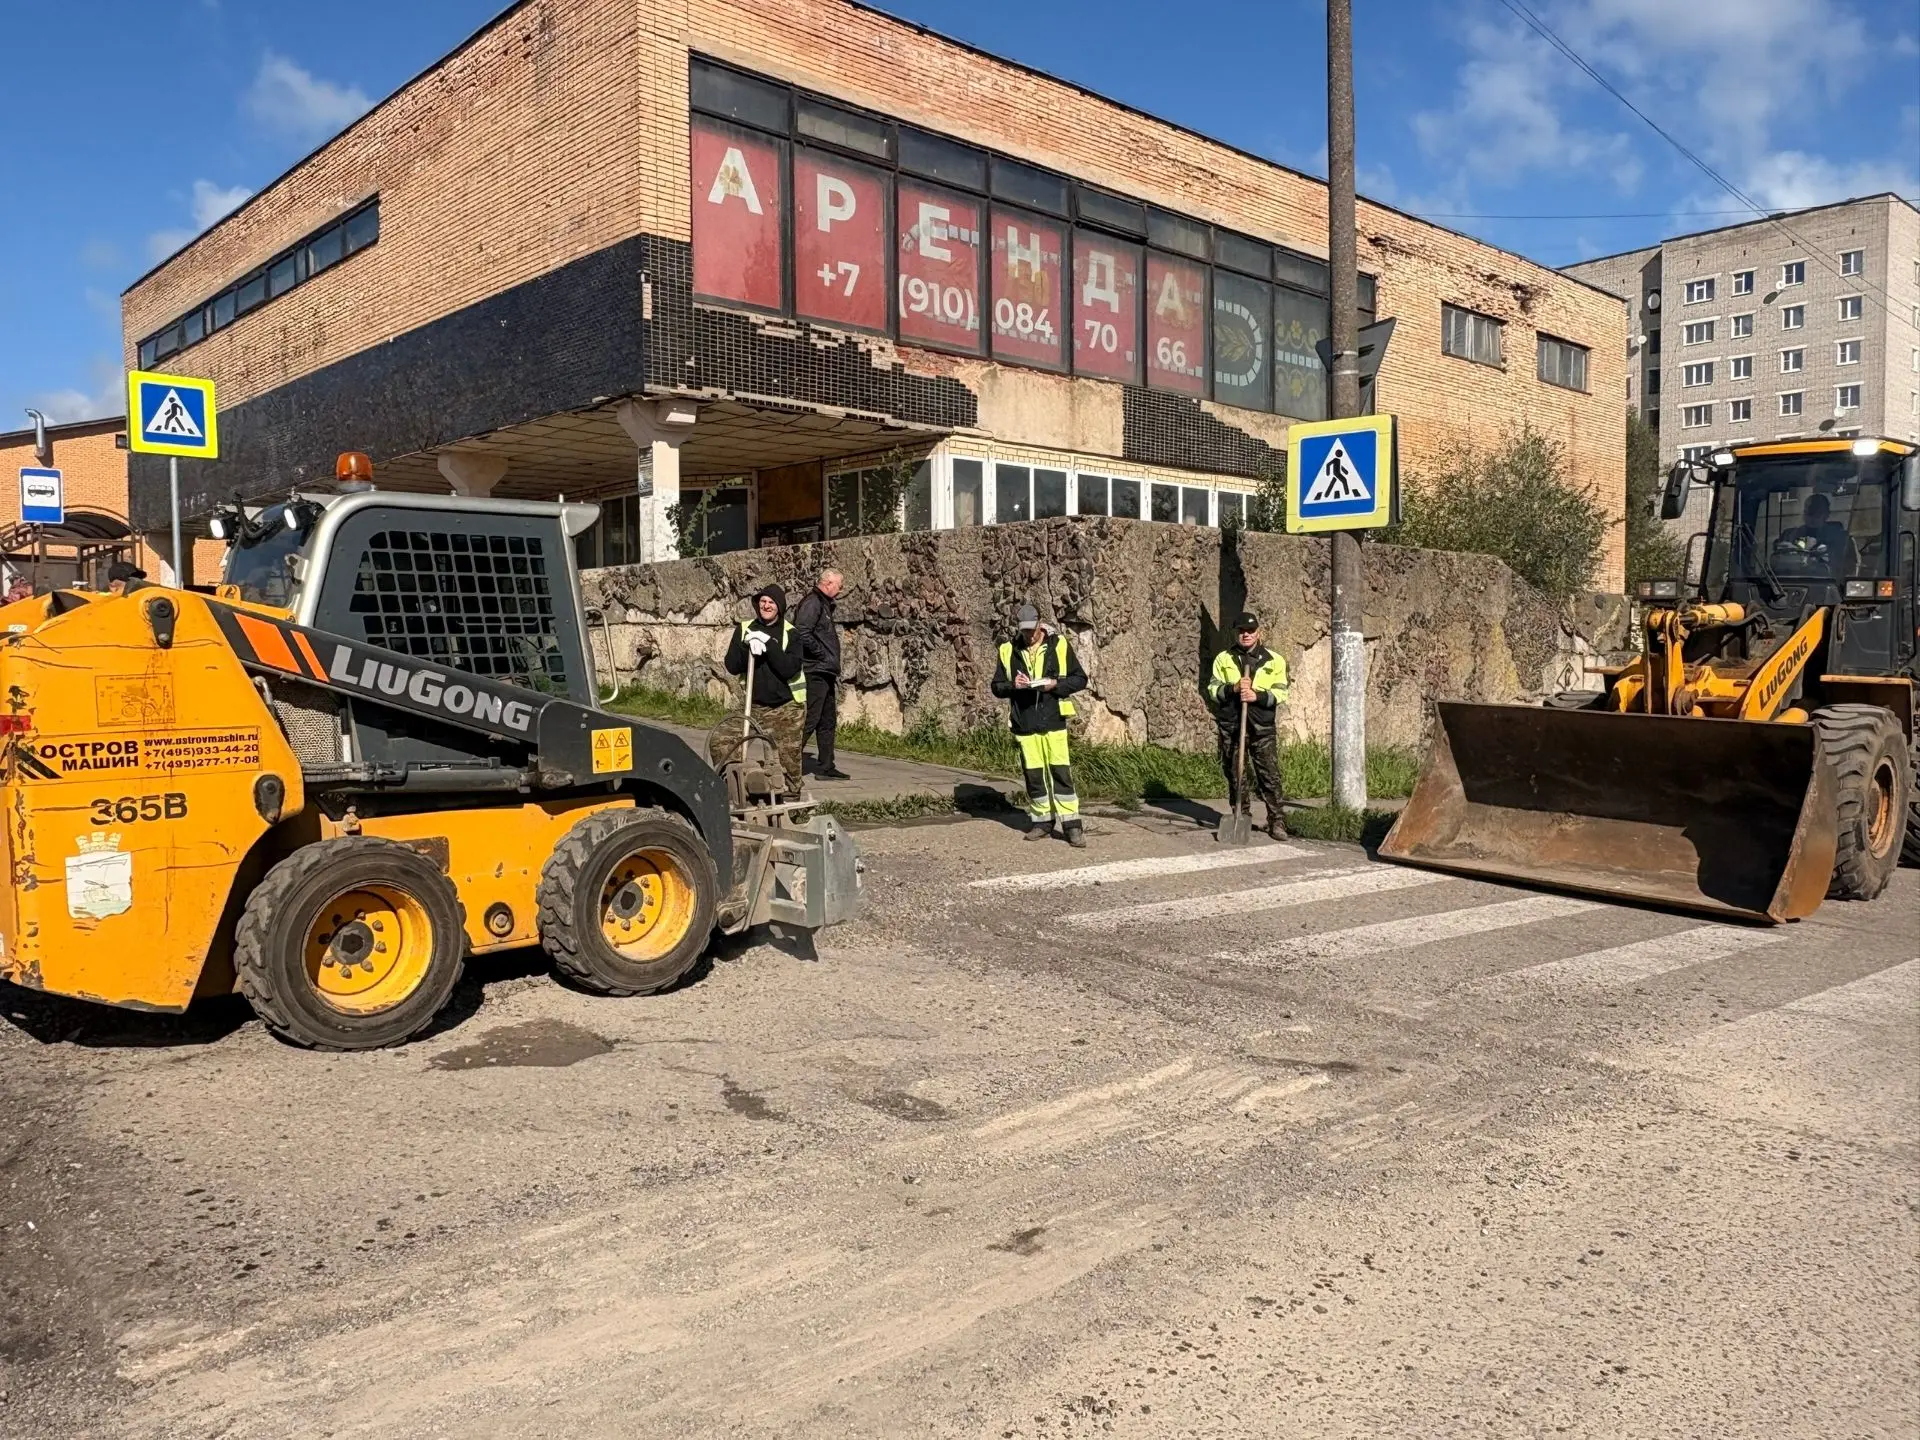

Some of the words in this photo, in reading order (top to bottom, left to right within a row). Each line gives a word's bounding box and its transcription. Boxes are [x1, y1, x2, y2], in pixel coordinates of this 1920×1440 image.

[707, 147, 1186, 321] АРЕНДА
[817, 261, 860, 297] +7
[900, 274, 974, 331] (910)
[995, 298, 1053, 338] 084
[1084, 320, 1118, 353] 70
[1156, 337, 1187, 368] 66
[40, 740, 139, 759] ОСТРОВ
[144, 733, 259, 747] www.ostrovmashin.ru
[62, 755, 139, 772] МАШИН
